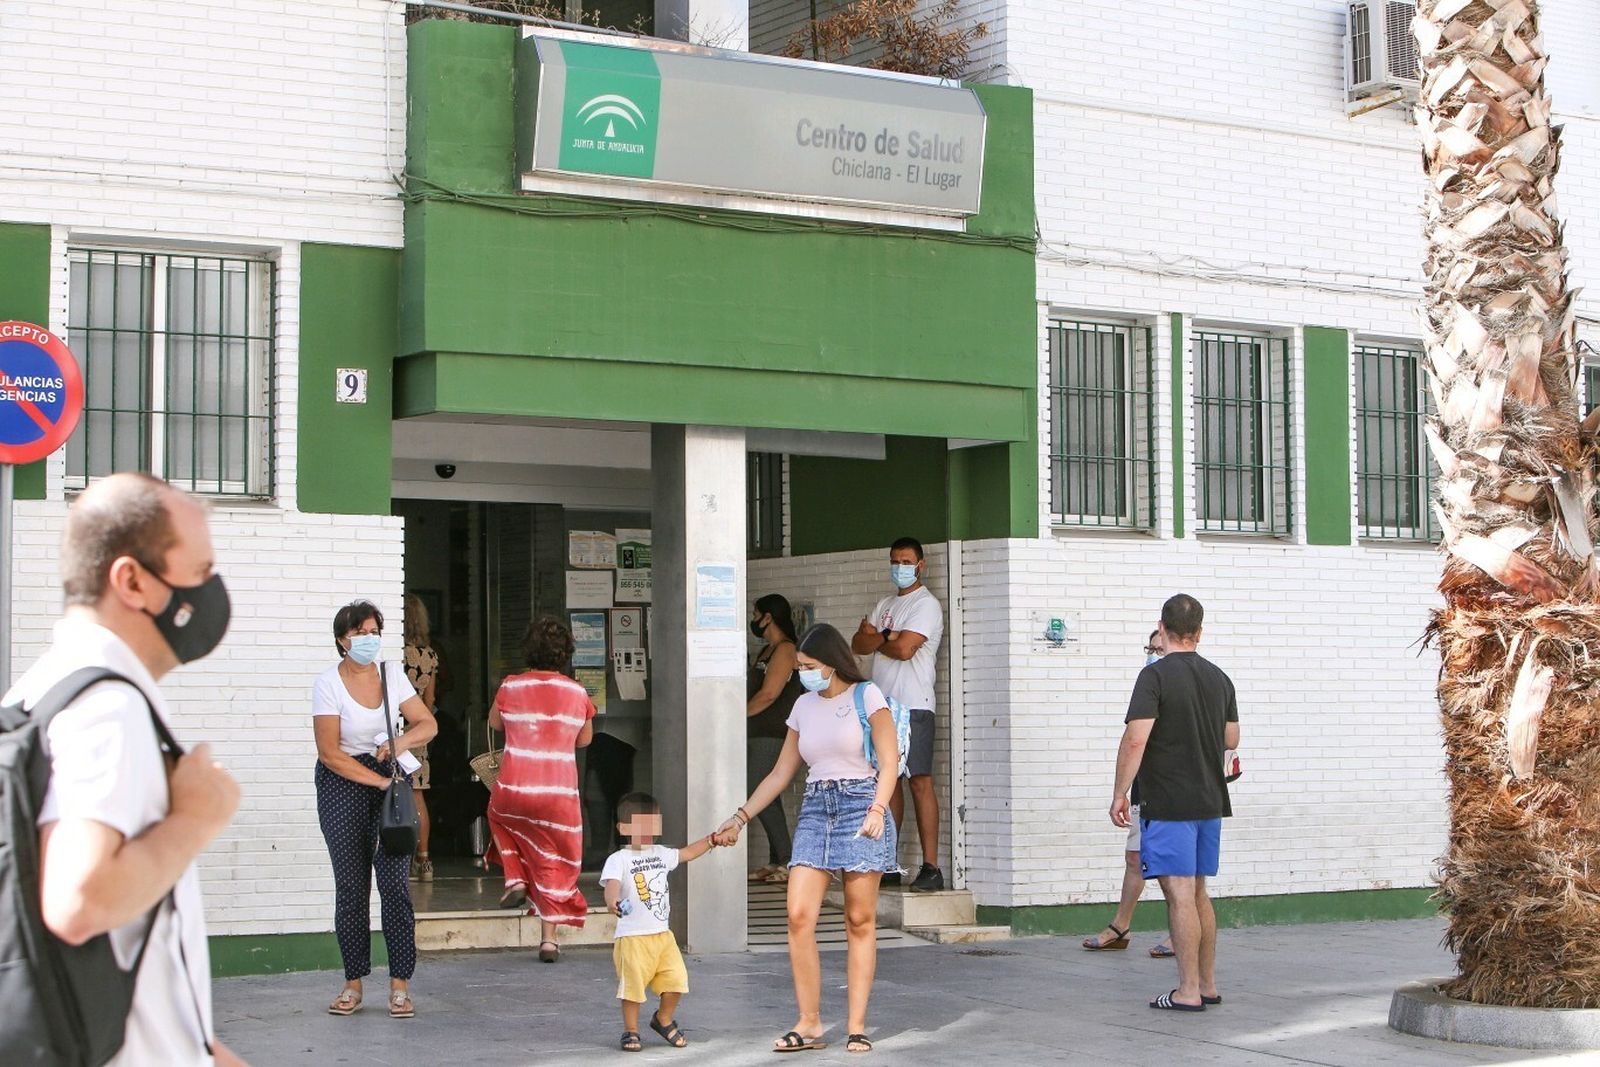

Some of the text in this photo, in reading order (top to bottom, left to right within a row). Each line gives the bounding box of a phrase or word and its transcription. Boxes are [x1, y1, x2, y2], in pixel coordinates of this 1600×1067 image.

[572, 138, 644, 154] JUNTA DE ANDALUCIA
[796, 118, 965, 164] Centro de Salud
[832, 156, 891, 181] Chiclana
[907, 164, 920, 184] El
[924, 167, 962, 191] Lugar
[0, 325, 49, 345] CEPTO
[345, 374, 358, 397] 9
[0, 390, 56, 403] GENCIAS
